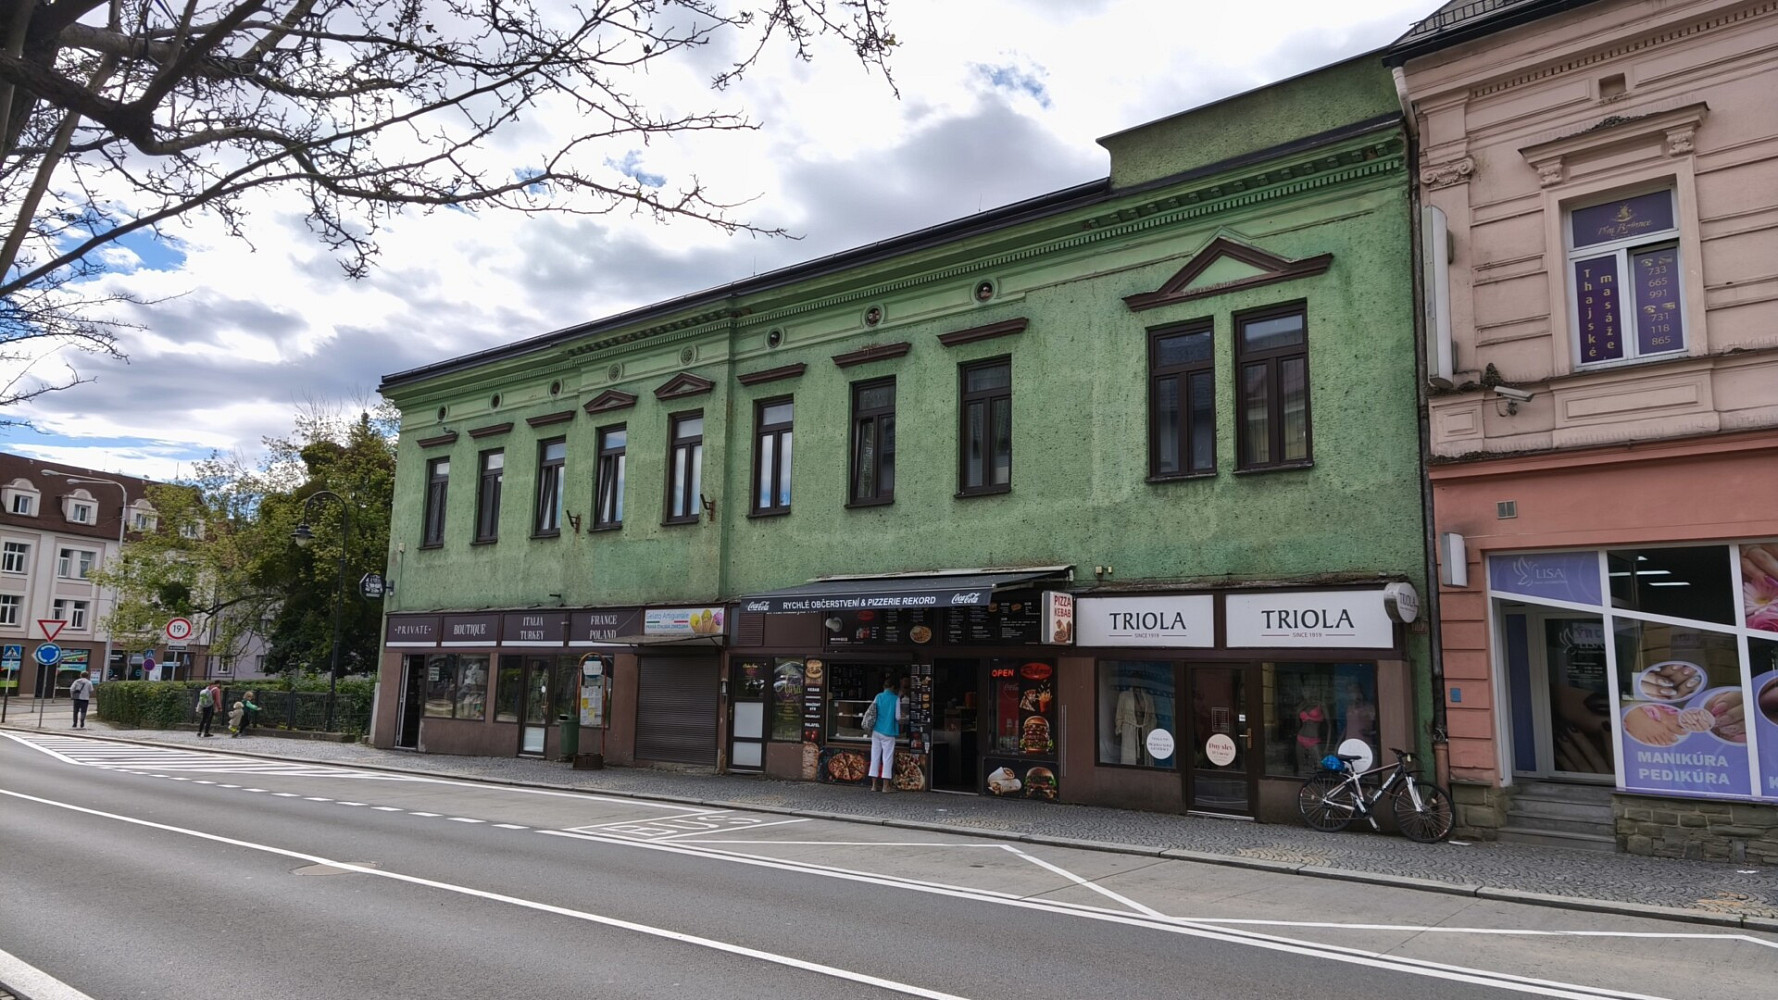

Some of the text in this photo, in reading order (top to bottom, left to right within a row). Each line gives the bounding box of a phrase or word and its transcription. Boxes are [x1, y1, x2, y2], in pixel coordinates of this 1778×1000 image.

[1648, 265, 1667, 276] 733
[1648, 277, 1668, 288] 665
[1649, 289, 1667, 299] 991
[1583, 268, 1597, 357] Thajské
[1600, 275, 1615, 349] masáže
[1651, 312, 1669, 322] 731
[1651, 324, 1670, 334] 118
[1651, 336, 1671, 346] 865
[1536, 568, 1564, 579] LISA
[782, 596, 936, 610] RYCHLÉ OBČERSTVENÍ & PIZZERIE REKORD
[1054, 595, 1072, 607] PIZZA
[1054, 607, 1072, 618] KEBAB
[523, 616, 544, 626] ITALIA
[590, 614, 618, 625] FRANCE
[1108, 612, 1187, 630] TRIOLA
[1260, 608, 1355, 629] TRIOLA
[453, 623, 487, 636] BOUTIQUE
[520, 630, 545, 640] TURKEY
[589, 629, 617, 640] POLAND
[991, 668, 1015, 677] OPEN
[1637, 751, 1729, 767] MANIKÚRA
[1638, 768, 1730, 785] PEDIKÚRA
